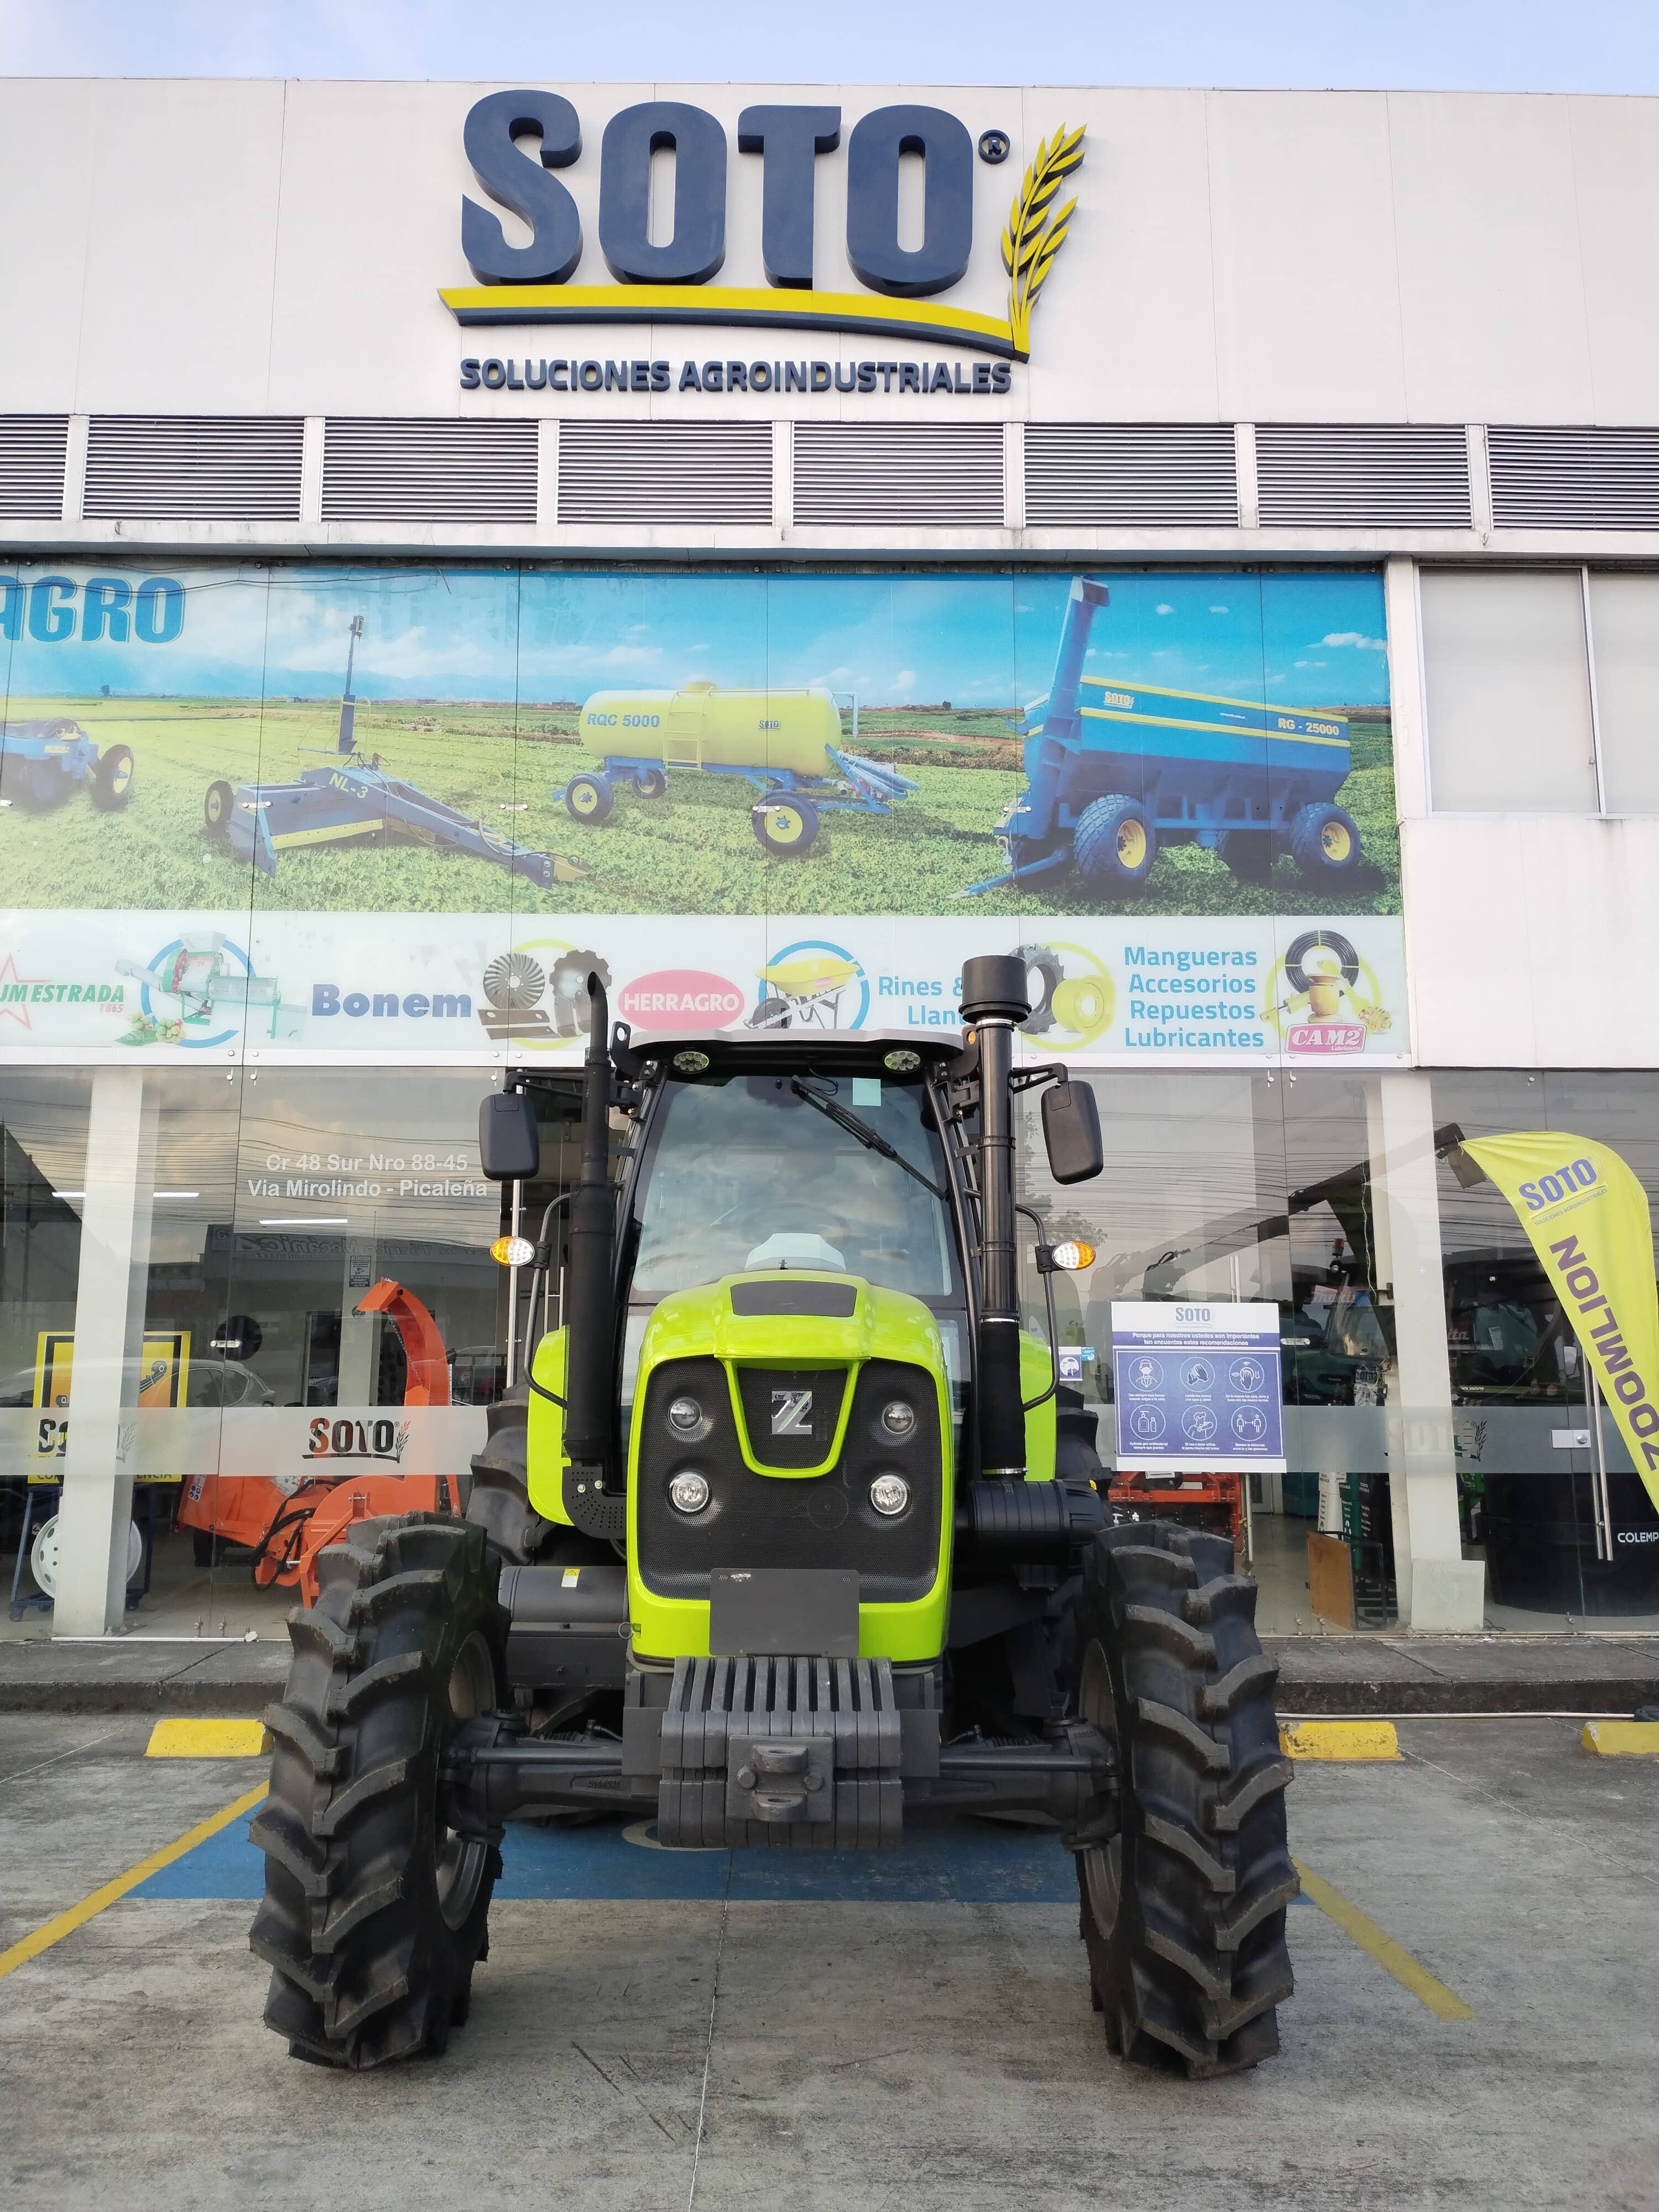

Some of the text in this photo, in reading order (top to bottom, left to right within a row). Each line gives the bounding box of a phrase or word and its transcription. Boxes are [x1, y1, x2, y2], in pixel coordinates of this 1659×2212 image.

[461, 90, 974, 297] SOTO
[460, 358, 1011, 393] SOLUCIONES AGROINDUSTRIALES
[587, 713, 660, 727] RQC 5000
[1278, 718, 1295, 729] RG
[1306, 722, 1339, 735] 25000
[329, 773, 368, 798] NL-3
[1125, 947, 1257, 971] Mangueras
[879, 976, 942, 995] Rines
[1129, 974, 1255, 993] Accesorios
[31, 985, 123, 1002] ESTRADA
[312, 984, 471, 1018] Bonem
[624, 993, 739, 1011] HERRAGRO
[100, 1004, 123, 1013] 1865
[909, 1005, 966, 1025] Llant
[1131, 1000, 1255, 1024] Repuestos
[1125, 1027, 1264, 1047] Lubricantes
[1292, 1030, 1360, 1046] CAM2
[267, 1154, 468, 1171] Cr 48 Sur Nro 88-45
[286, 1180, 380, 1197] Mirolindo
[400, 1179, 487, 1197] Picaleña
[1519, 1159, 1597, 1211] SOTO
[1176, 1307, 1211, 1322] SOTO
[309, 1418, 394, 1453] SOTO
[1618, 1532, 1659, 1543] COLEMP
